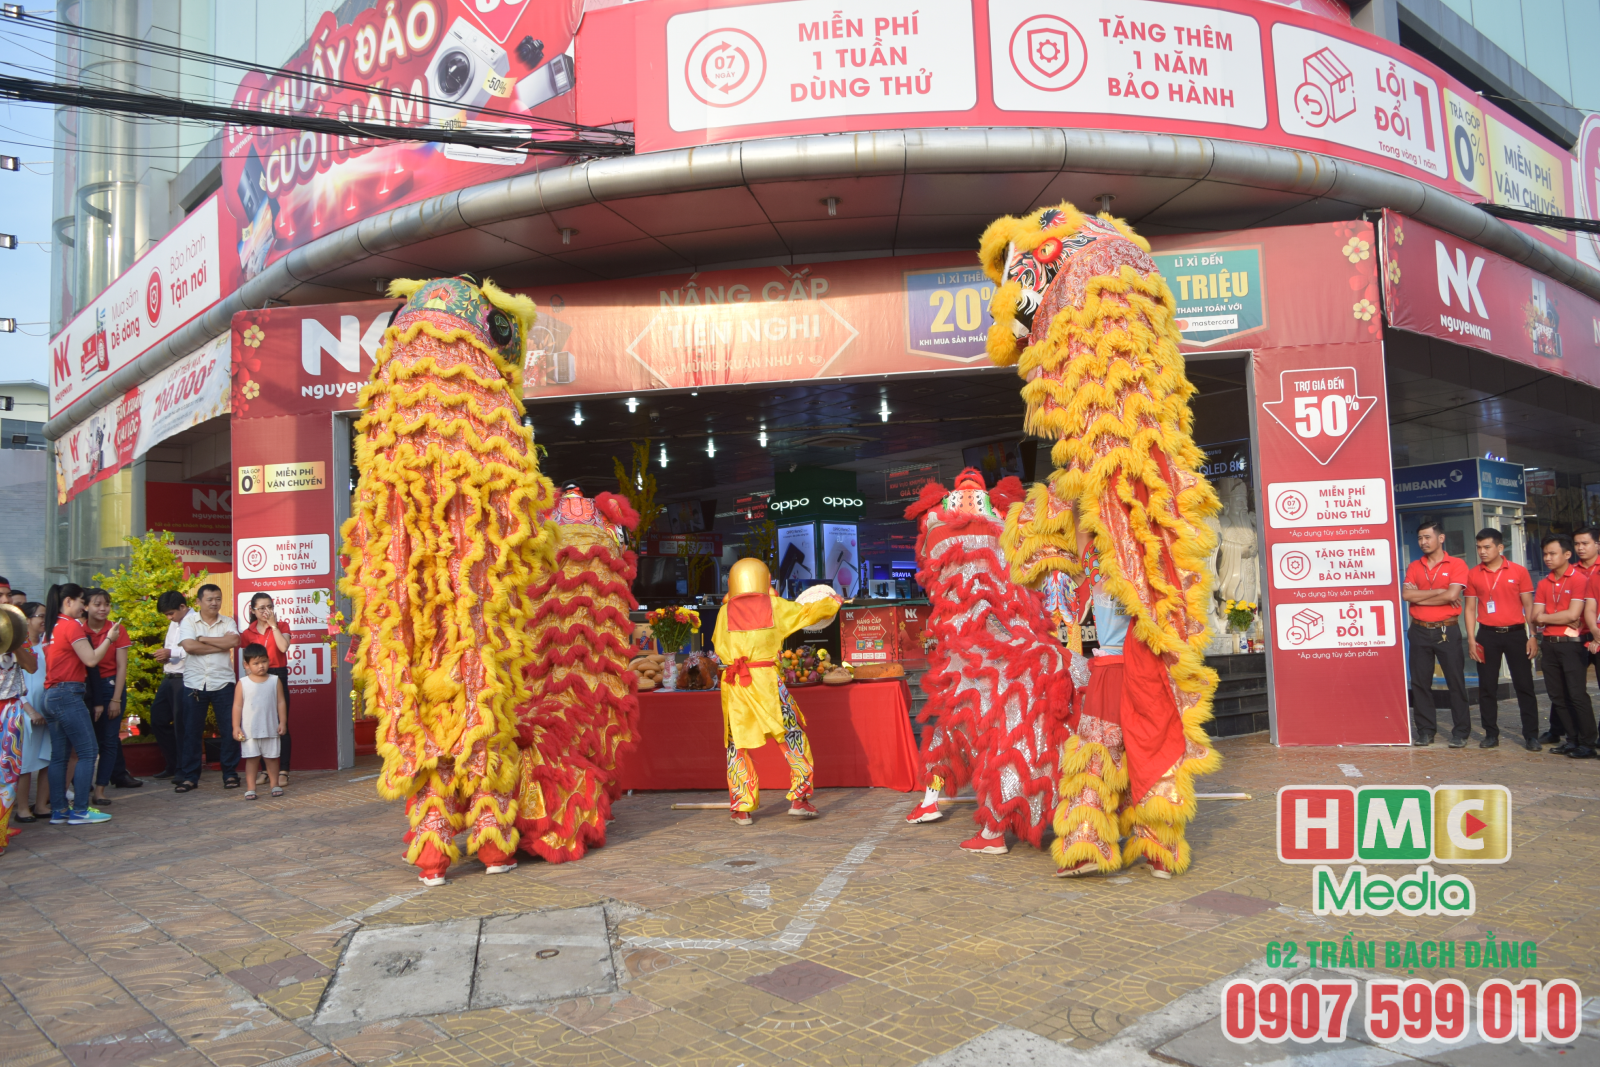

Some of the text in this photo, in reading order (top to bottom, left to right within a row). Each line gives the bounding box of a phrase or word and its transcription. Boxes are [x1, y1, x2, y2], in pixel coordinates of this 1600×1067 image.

[798, 10, 919, 43] MIỄN PHÍ
[1099, 15, 1233, 51] TẶNG THÊM
[354, 0, 436, 73] ĐẢO
[714, 55, 735, 70] 07
[812, 37, 907, 70] 1 TUẦN
[1133, 50, 1208, 77] 1 NĂM
[715, 70, 736, 79] NGÀY
[1376, 61, 1406, 101] LỖI
[486, 78, 508, 96] -50%
[790, 68, 933, 102] DÙNG THỬ
[1108, 72, 1234, 108] BẢO HÀNH
[1374, 100, 1411, 141] ĐỔI
[1413, 80, 1435, 153] 1
[1449, 101, 1480, 130] TRẢ GÓP
[1378, 141, 1437, 171] Trong vòng năm
[1454, 124, 1485, 182] 0%
[1504, 145, 1532, 179] MIỄN
[1534, 164, 1552, 191] PHÍ
[1495, 170, 1520, 203] VẬN
[170, 233, 206, 275] Bảo hành
[1174, 253, 1223, 268] LÌ XÌ ĐẾN
[170, 260, 207, 308] Tận nơi
[938, 274, 945, 285] LÌ
[949, 273, 960, 284] XÌ
[1176, 269, 1249, 302] TRIỆU
[1435, 240, 1489, 320] NK
[659, 267, 829, 313] NÂNG CẤP
[111, 302, 126, 322] Mua
[1176, 303, 1242, 314] THANH TOÁN VỚI
[741, 314, 821, 343] NGHI
[1191, 318, 1235, 327] mastercard
[111, 317, 140, 350] Dễ dàng
[951, 335, 966, 344] SẢN
[302, 312, 394, 376] NK
[53, 334, 72, 387] NK
[681, 358, 720, 374] MỪNG
[765, 353, 793, 367] NHƯ
[796, 352, 804, 365] Ý
[1294, 375, 1345, 392] TRỢ GIÁ ĐẾN
[1294, 394, 1360, 439] 50%
[276, 467, 314, 477] MIỄN PHÍ
[1199, 462, 1227, 476] QLED
[267, 476, 323, 489] VẬN CHUYỂN
[1319, 485, 1365, 498] MIỄN PHÍ
[1495, 477, 1519, 489] EXIMBANK
[1325, 497, 1361, 508] 1 TUẦN
[1316, 507, 1371, 520] DÙNG THỬ
[1304, 529, 1321, 537] dụng
[1323, 528, 1334, 536] tùy
[1349, 526, 1370, 535] phẩm
[178, 538, 220, 547] GIÁM ĐỐC
[276, 540, 313, 551] MIỄN PHÍ
[287, 550, 309, 561] TUẦN
[1315, 546, 1375, 560] TẶNG THÊM
[273, 560, 317, 571] DÙNG THỬ
[1339, 559, 1363, 568] NĂM
[1319, 569, 1375, 581] BẢO HÀNH
[1308, 590, 1326, 598] dụng
[1354, 587, 1374, 596] phẩm
[289, 607, 309, 615] NĂM
[905, 608, 918, 619] NK
[1339, 603, 1362, 619] LỖI
[293, 616, 318, 625] HÀNH
[1336, 619, 1364, 637] ĐỔI
[1370, 605, 1386, 636] 1
[311, 647, 324, 675] 1
[1312, 651, 1330, 659] dụng
[1332, 651, 1343, 659] tùy
[1358, 648, 1378, 658] phẩm
